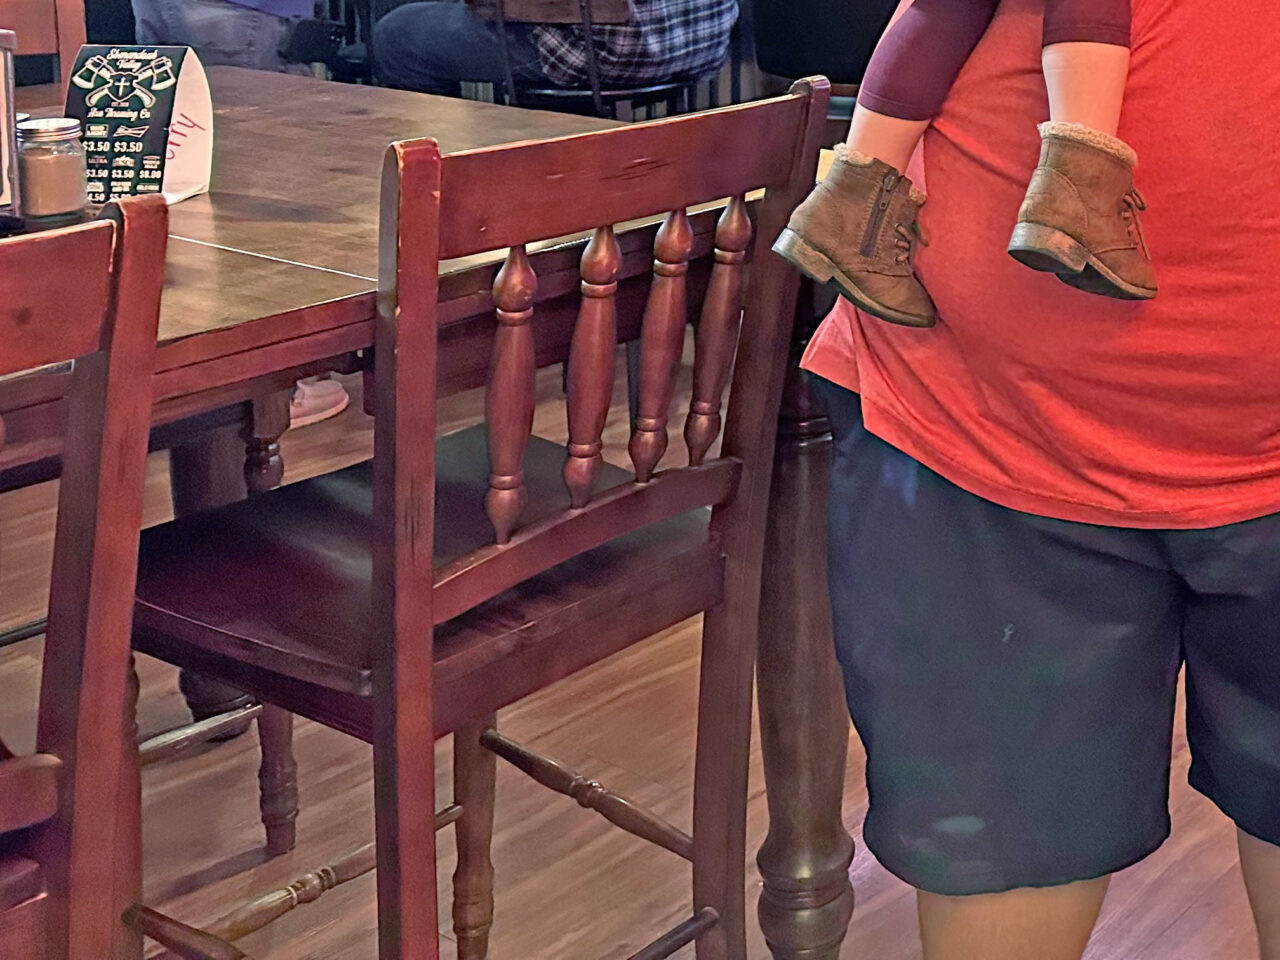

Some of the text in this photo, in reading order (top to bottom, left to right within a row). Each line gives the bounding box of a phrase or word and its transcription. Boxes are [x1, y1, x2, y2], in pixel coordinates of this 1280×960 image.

[83, 141, 143, 152] $3.50 $3.50
[111, 169, 135, 178] $3.50
